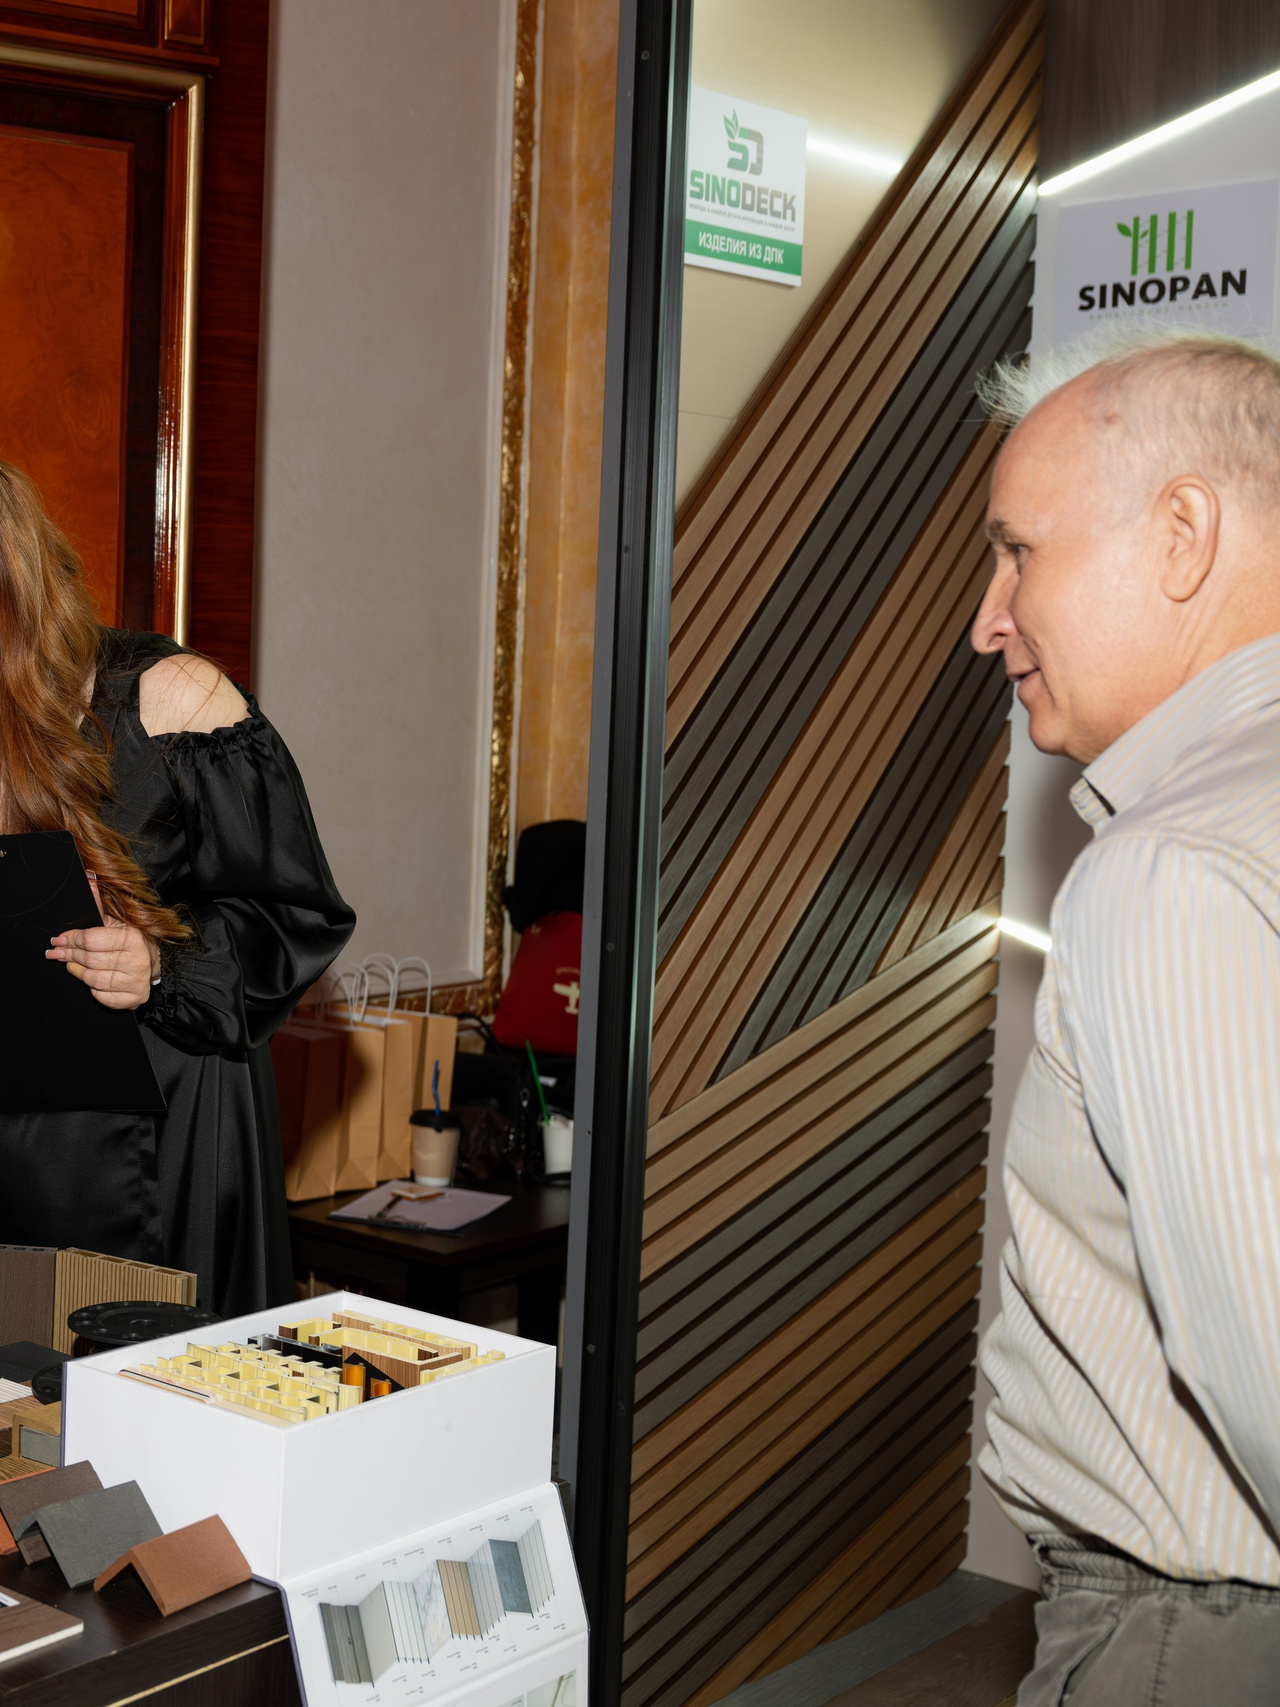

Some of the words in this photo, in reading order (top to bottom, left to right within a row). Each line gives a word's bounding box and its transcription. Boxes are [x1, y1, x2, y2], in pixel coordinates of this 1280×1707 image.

[689, 169, 797, 222] SINODECK
[698, 231, 747, 257] ИЗДЕЛИЯ
[748, 241, 762, 260] ИЗ
[763, 245, 785, 265] ДПК
[1078, 268, 1247, 311] SINOPAN
